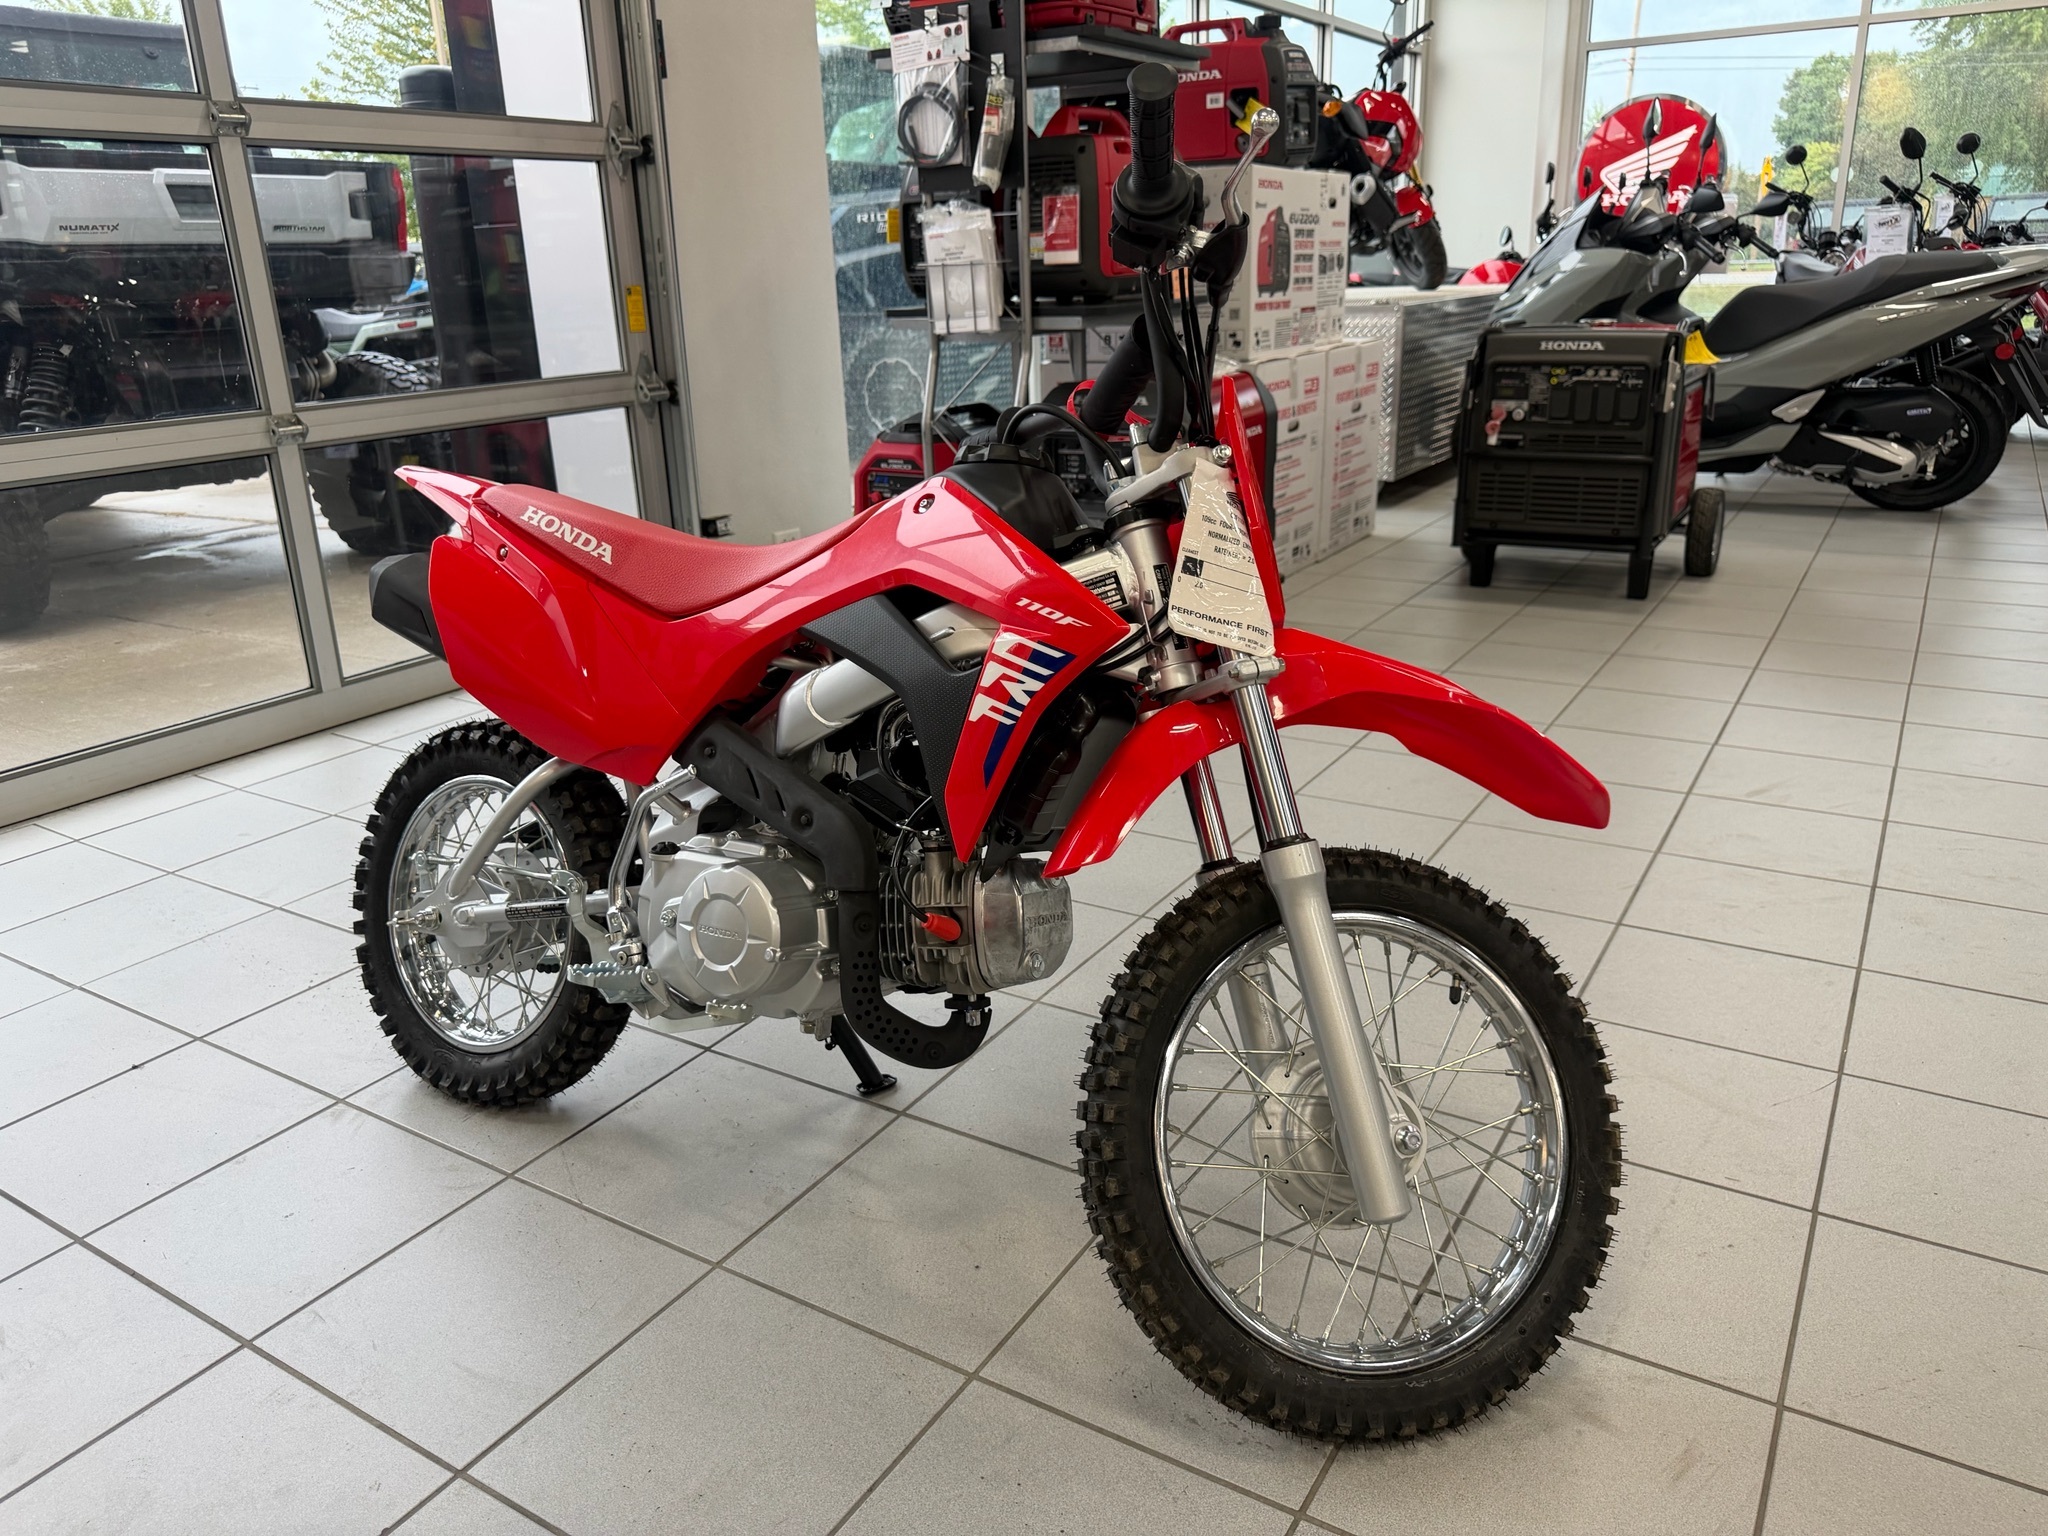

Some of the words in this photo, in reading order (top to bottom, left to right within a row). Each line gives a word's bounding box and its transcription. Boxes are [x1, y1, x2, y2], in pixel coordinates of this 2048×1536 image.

[1178, 69, 1222, 83] ONDA
[1600, 190, 1691, 207] HOA
[59, 222, 119, 232] NUMATIX
[1540, 340, 1605, 350] HONDA
[520, 505, 612, 565] HONDA
[1208, 530, 1240, 546] NORMALIZED
[1015, 597, 1092, 627] 110F
[1171, 604, 1243, 629] PERFORMANCE
[968, 632, 1066, 725] CRF
[699, 924, 742, 941] HONDA
